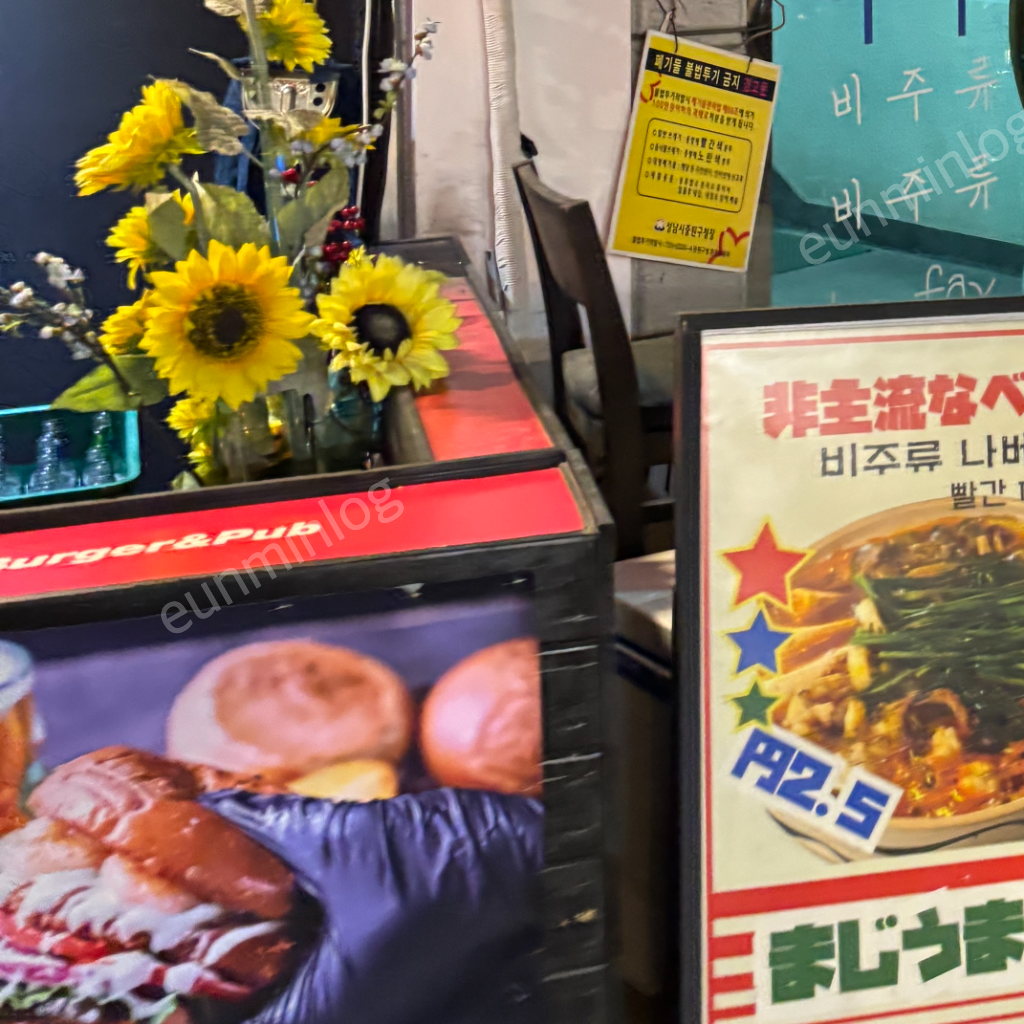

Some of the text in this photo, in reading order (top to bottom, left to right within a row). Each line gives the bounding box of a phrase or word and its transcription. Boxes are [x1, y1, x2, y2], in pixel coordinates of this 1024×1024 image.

[654, 54, 682, 75] 폐기물
[685, 61, 721, 85] 불법투기
[722, 71, 741, 90] 금지
[820, 439, 943, 477] 비주류
[950, 479, 1007, 510] 빨간
[0, 521, 322, 571] urger&Pub
